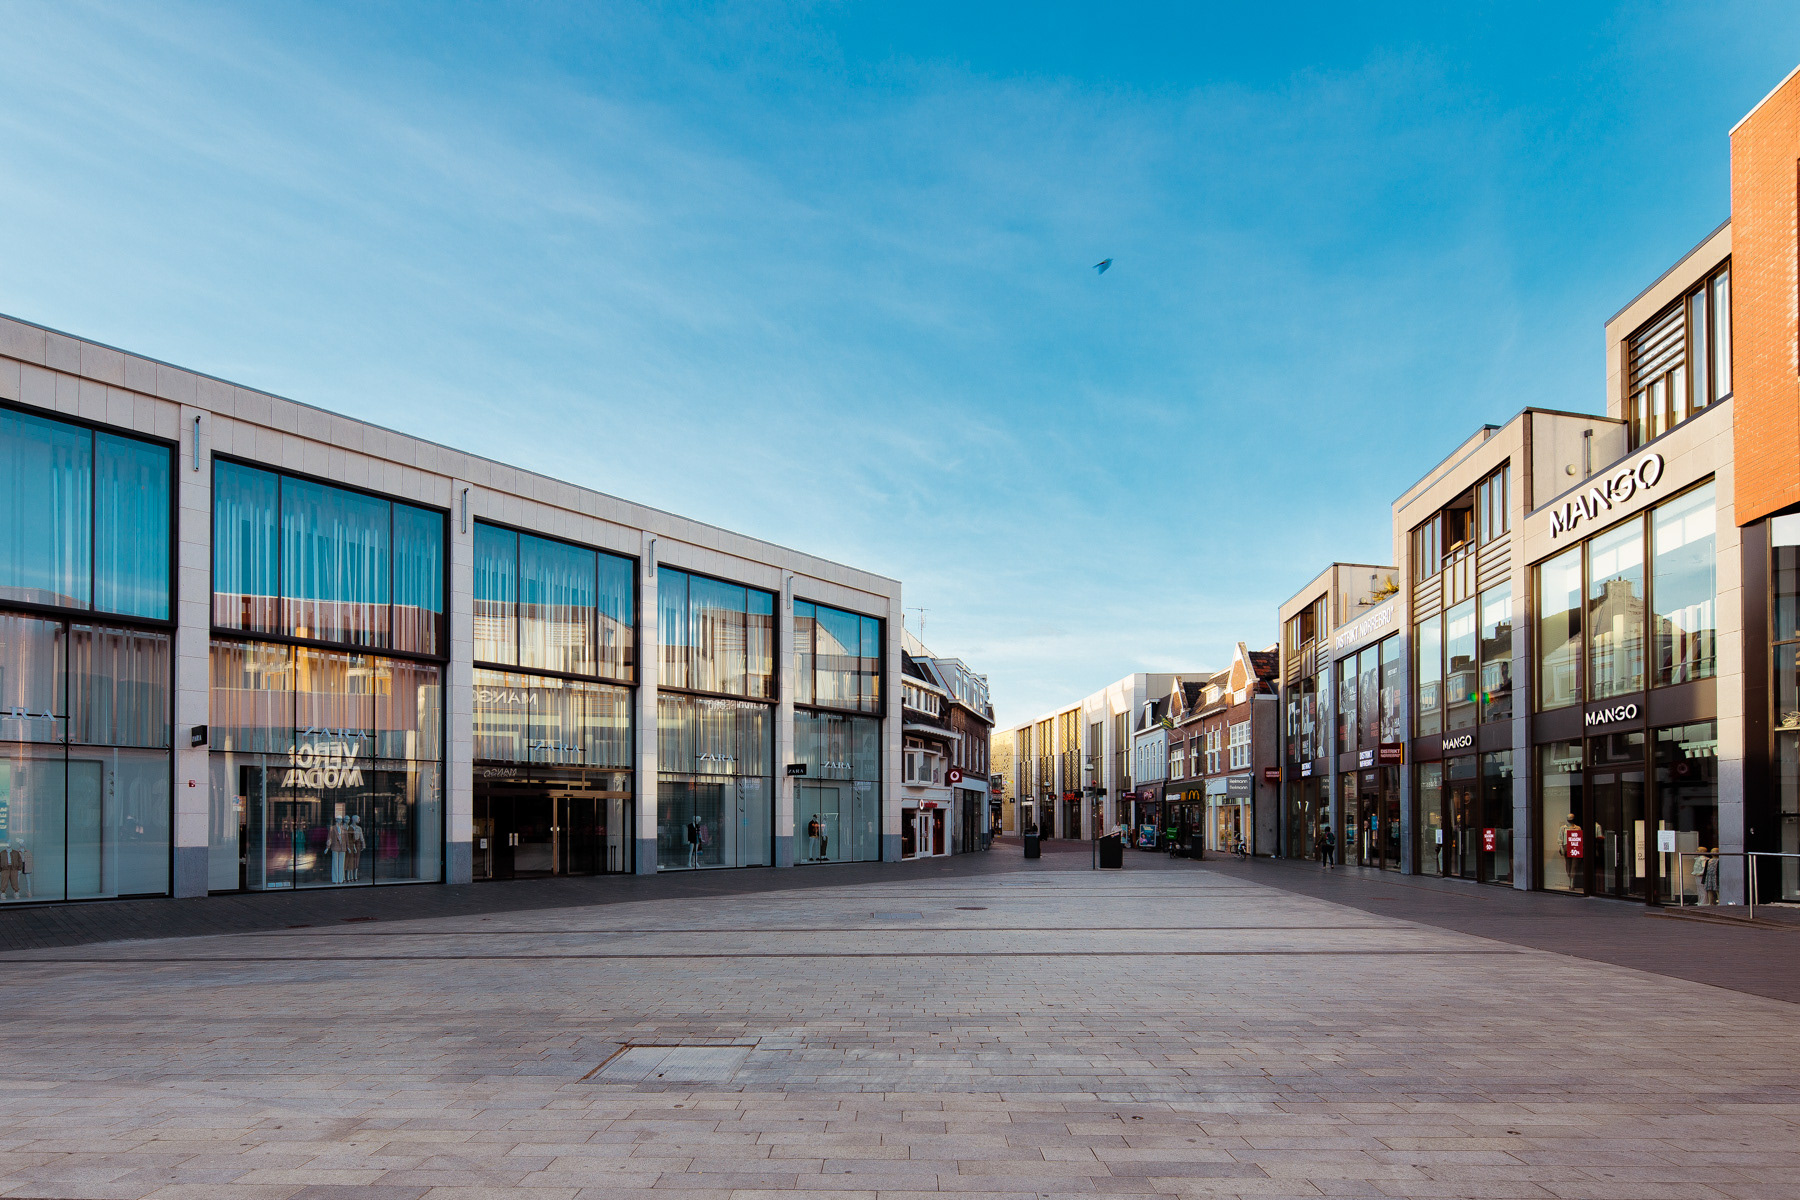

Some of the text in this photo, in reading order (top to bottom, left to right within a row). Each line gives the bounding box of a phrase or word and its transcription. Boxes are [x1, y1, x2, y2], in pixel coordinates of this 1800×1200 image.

[1549, 453, 1664, 539] MANGO
[1585, 703, 1637, 727] MANGO
[302, 725, 368, 740] ZARA
[533, 741, 581, 753] ZARA
[1442, 735, 1472, 750] MANGO
[700, 753, 734, 762] ZARA
[824, 761, 851, 770] ZARA
